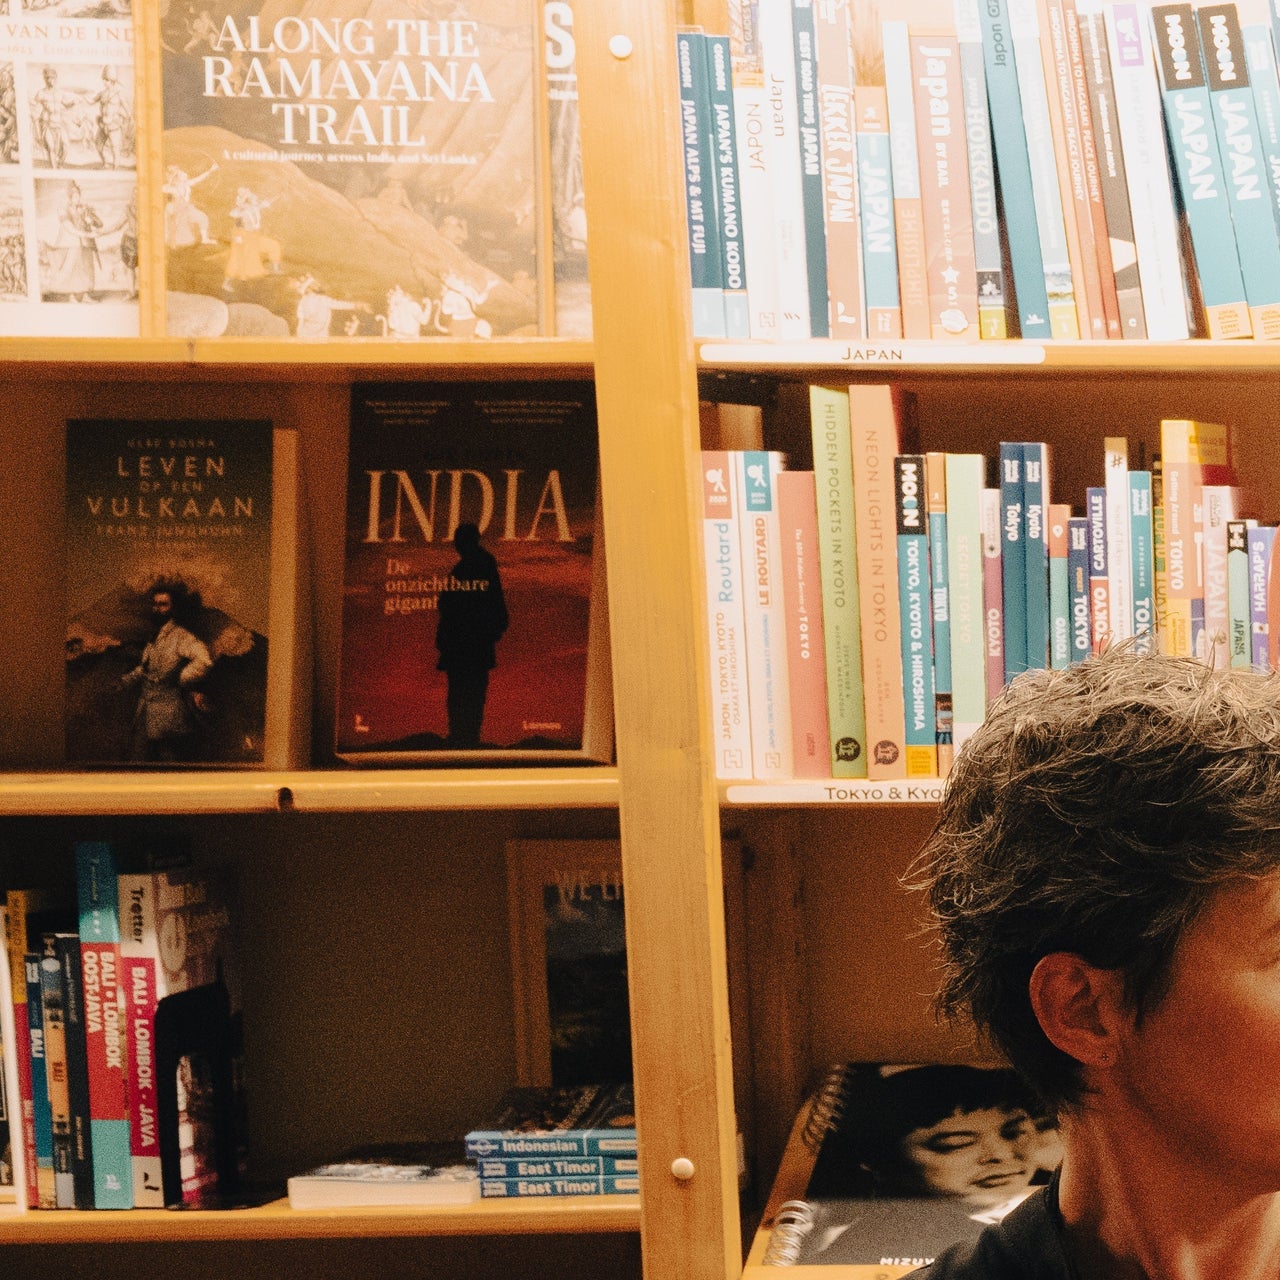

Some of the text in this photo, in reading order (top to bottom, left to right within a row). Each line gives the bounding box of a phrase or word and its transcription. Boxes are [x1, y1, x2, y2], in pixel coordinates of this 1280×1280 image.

[214, 15, 479, 57] ALONG THE
[1165, 15, 1192, 80] MOON
[1210, 15, 1236, 80] MOON
[202, 56, 494, 103] RAMAYANA
[770, 74, 784, 137] Japan
[919, 45, 951, 136] Japan
[271, 103, 425, 146] TRAIL
[1174, 94, 1218, 200] JAPAN
[1219, 94, 1262, 200] JAPAN
[862, 159, 892, 252] JAPAN
[842, 348, 902, 360] JAPAN
[118, 456, 225, 476] LEVEN
[900, 463, 919, 527] MOON
[87, 497, 253, 518] VULKAAN
[364, 469, 576, 543] INDIA
[824, 403, 846, 609] HIDDEN POCKETS IN KYOTO
[1093, 495, 1103, 570] CARTOVILLE
[385, 576, 489, 592] onzichtbare
[388, 558, 411, 575] De
[714, 522, 733, 602] Routard
[800, 615, 810, 659] TOKYO
[825, 787, 946, 801] TOKYO & KYO
[502, 1139, 578, 1153] Indonesian
